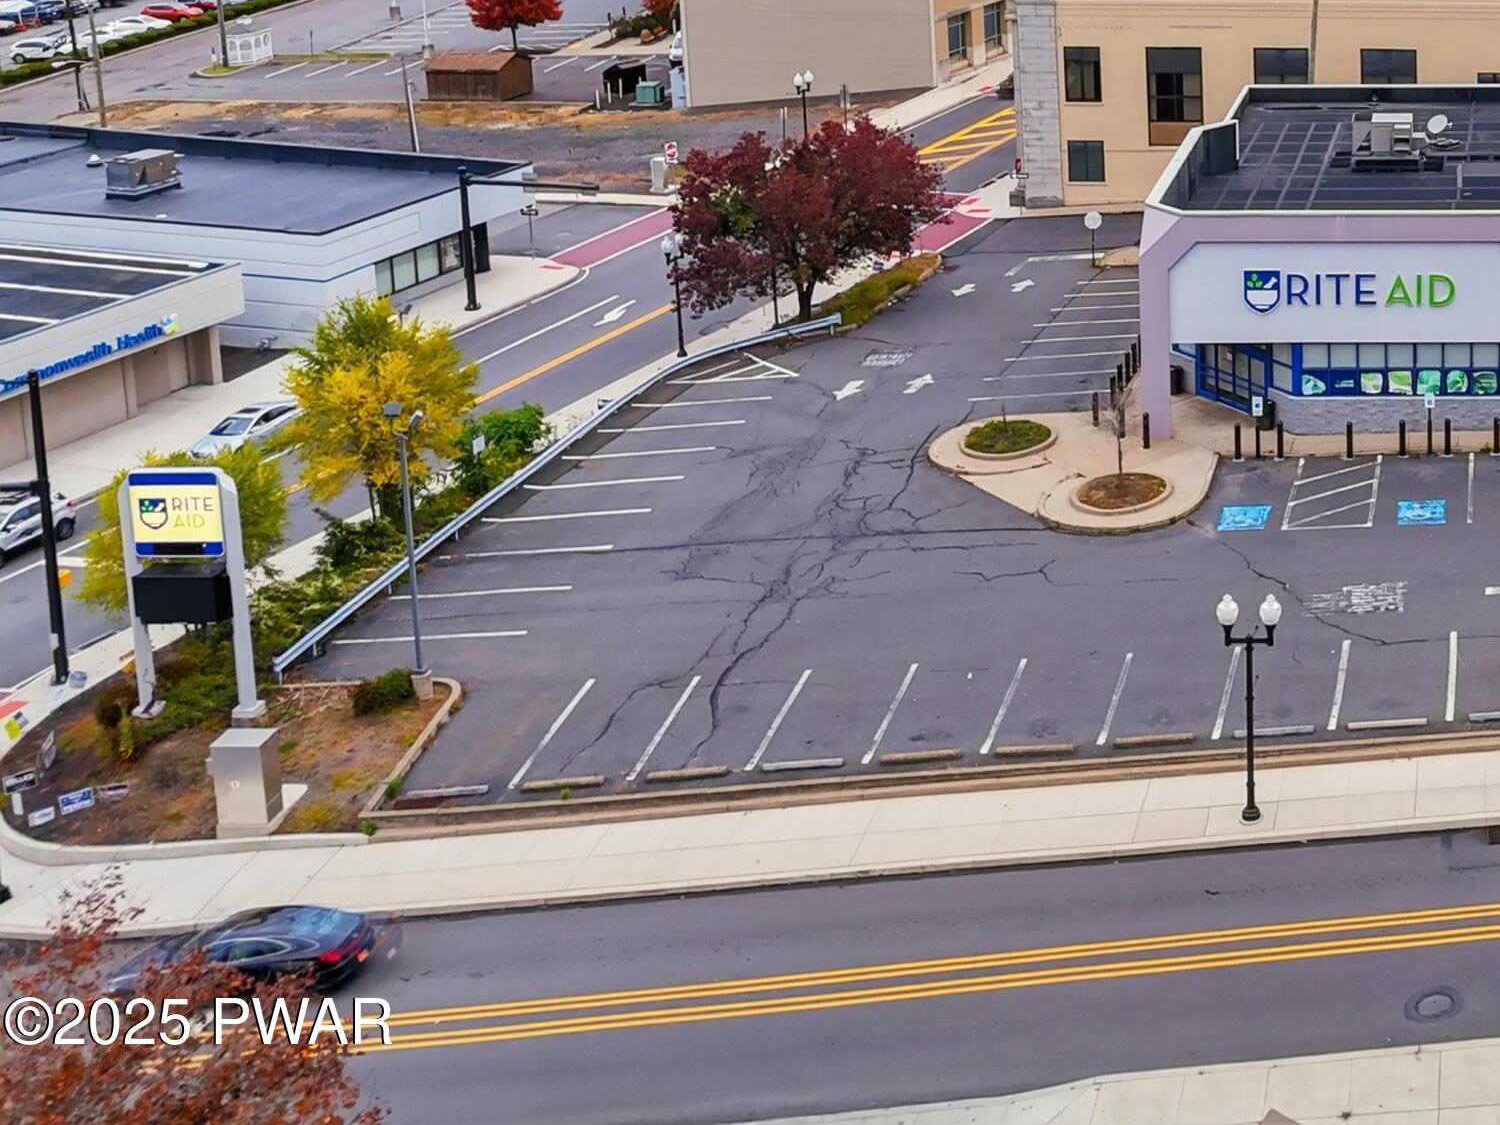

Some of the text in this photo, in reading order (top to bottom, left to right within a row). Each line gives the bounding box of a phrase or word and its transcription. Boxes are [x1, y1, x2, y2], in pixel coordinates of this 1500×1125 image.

[1286, 274, 1457, 308] RITE AID
[172, 497, 214, 512] RITE
[174, 514, 206, 529] AID
